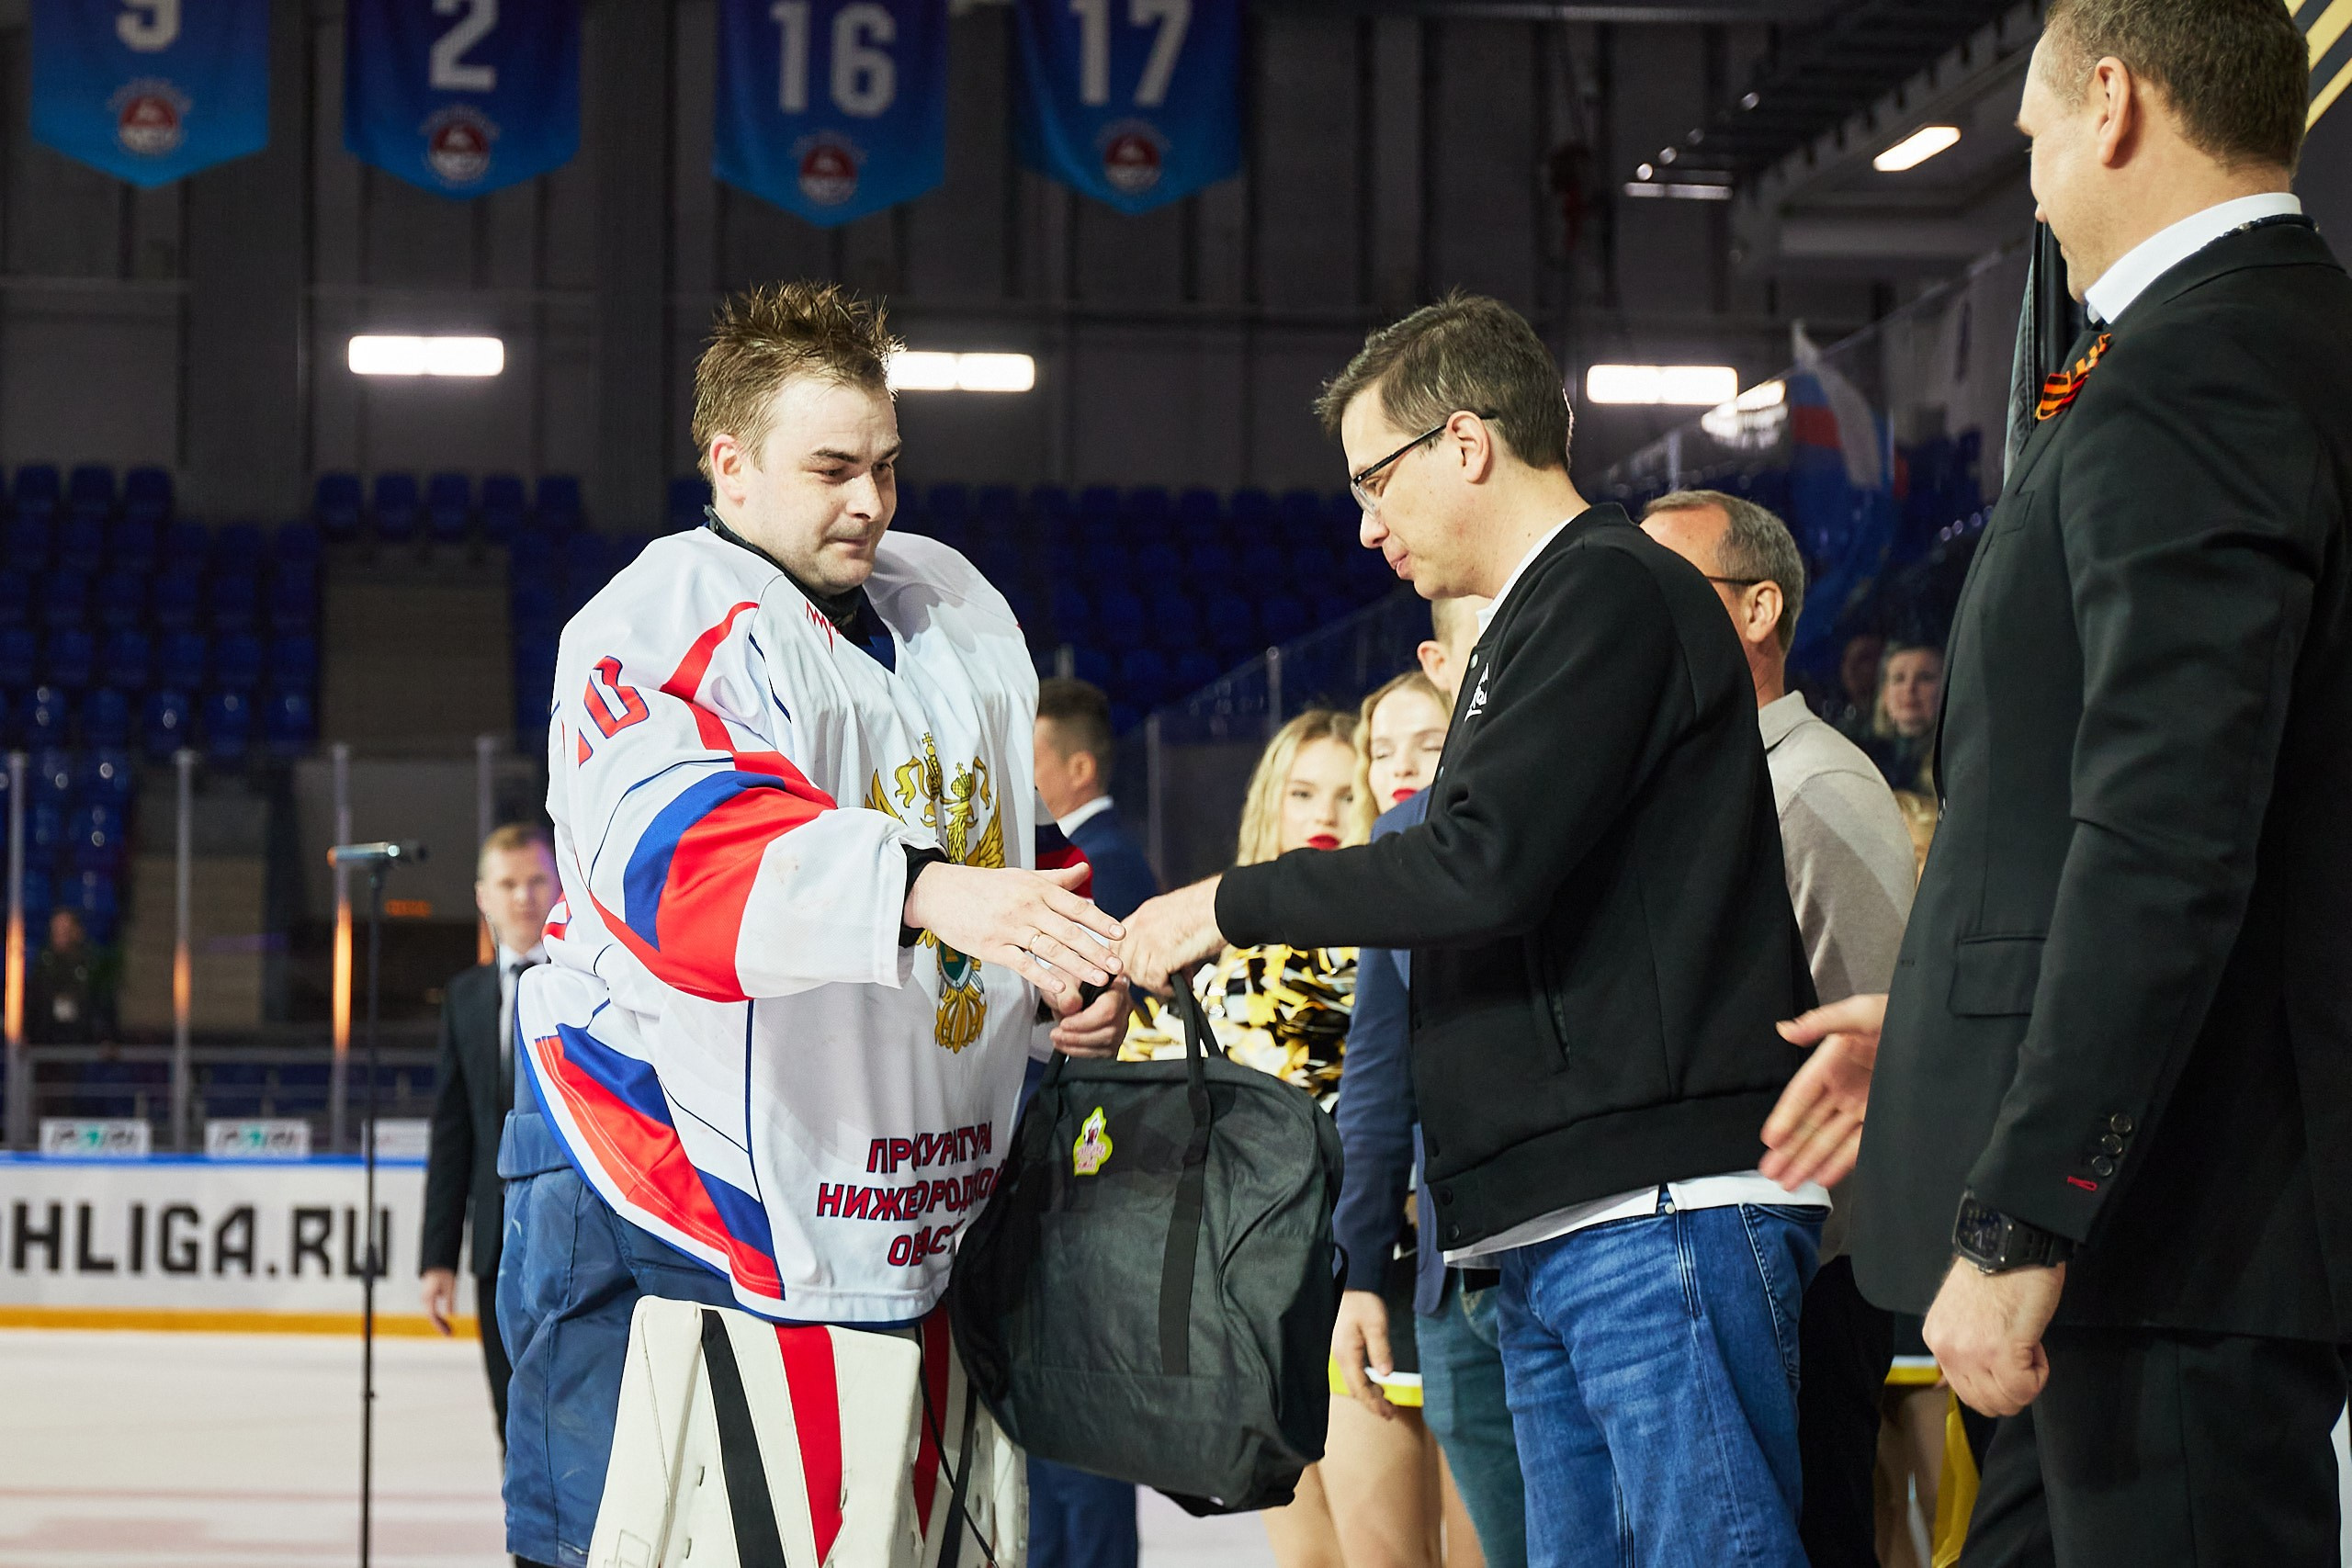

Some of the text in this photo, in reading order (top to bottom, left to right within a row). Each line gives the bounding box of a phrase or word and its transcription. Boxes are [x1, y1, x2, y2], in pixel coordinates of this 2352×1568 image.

[429, 0, 499, 91] 2
[770, 3, 897, 117] 16
[1070, 0, 1192, 107] 17
[0, 1200, 393, 1279] HLIGA.RU
